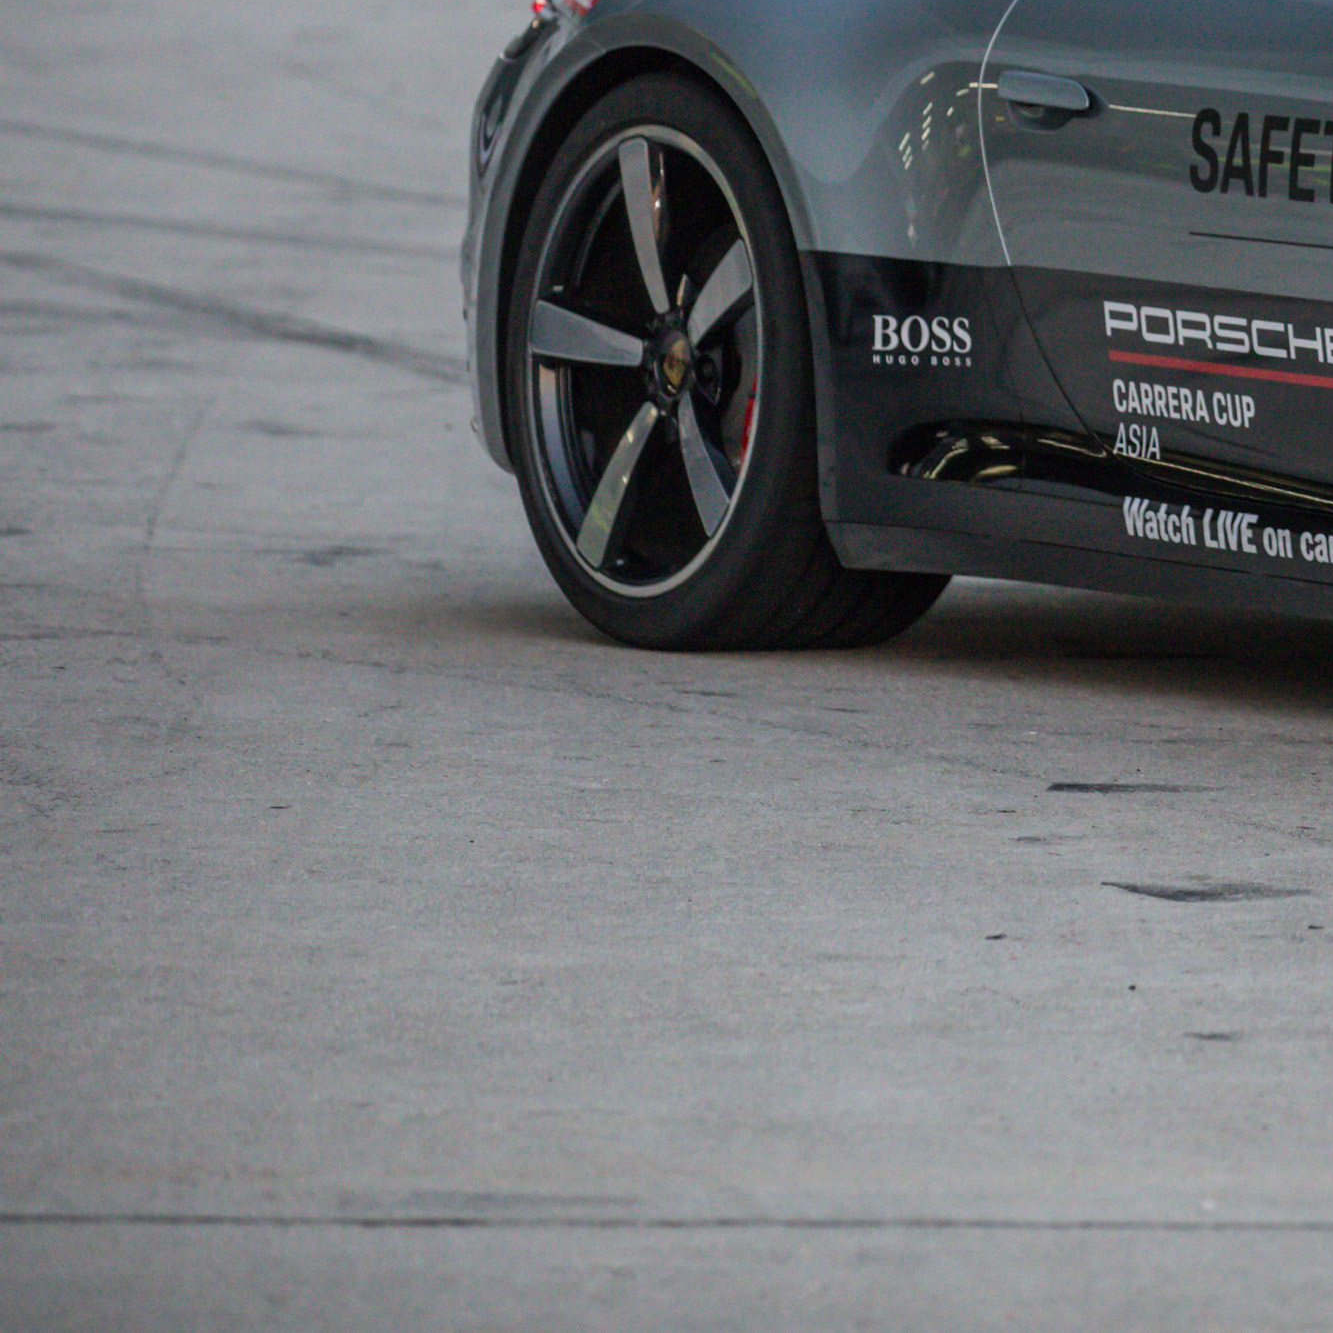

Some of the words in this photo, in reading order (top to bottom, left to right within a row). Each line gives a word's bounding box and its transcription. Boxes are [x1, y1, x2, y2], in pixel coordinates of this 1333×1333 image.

[872, 315, 972, 354] BOSS
[872, 354, 920, 366] HUGO
[930, 356, 972, 368] BOSS
[1112, 378, 1210, 423] CARRERA
[1212, 391, 1256, 429] CUP
[1113, 422, 1161, 461] ASIA
[1122, 496, 1197, 546] Watch
[1202, 508, 1259, 554] LIVE
[1262, 525, 1294, 559] on
